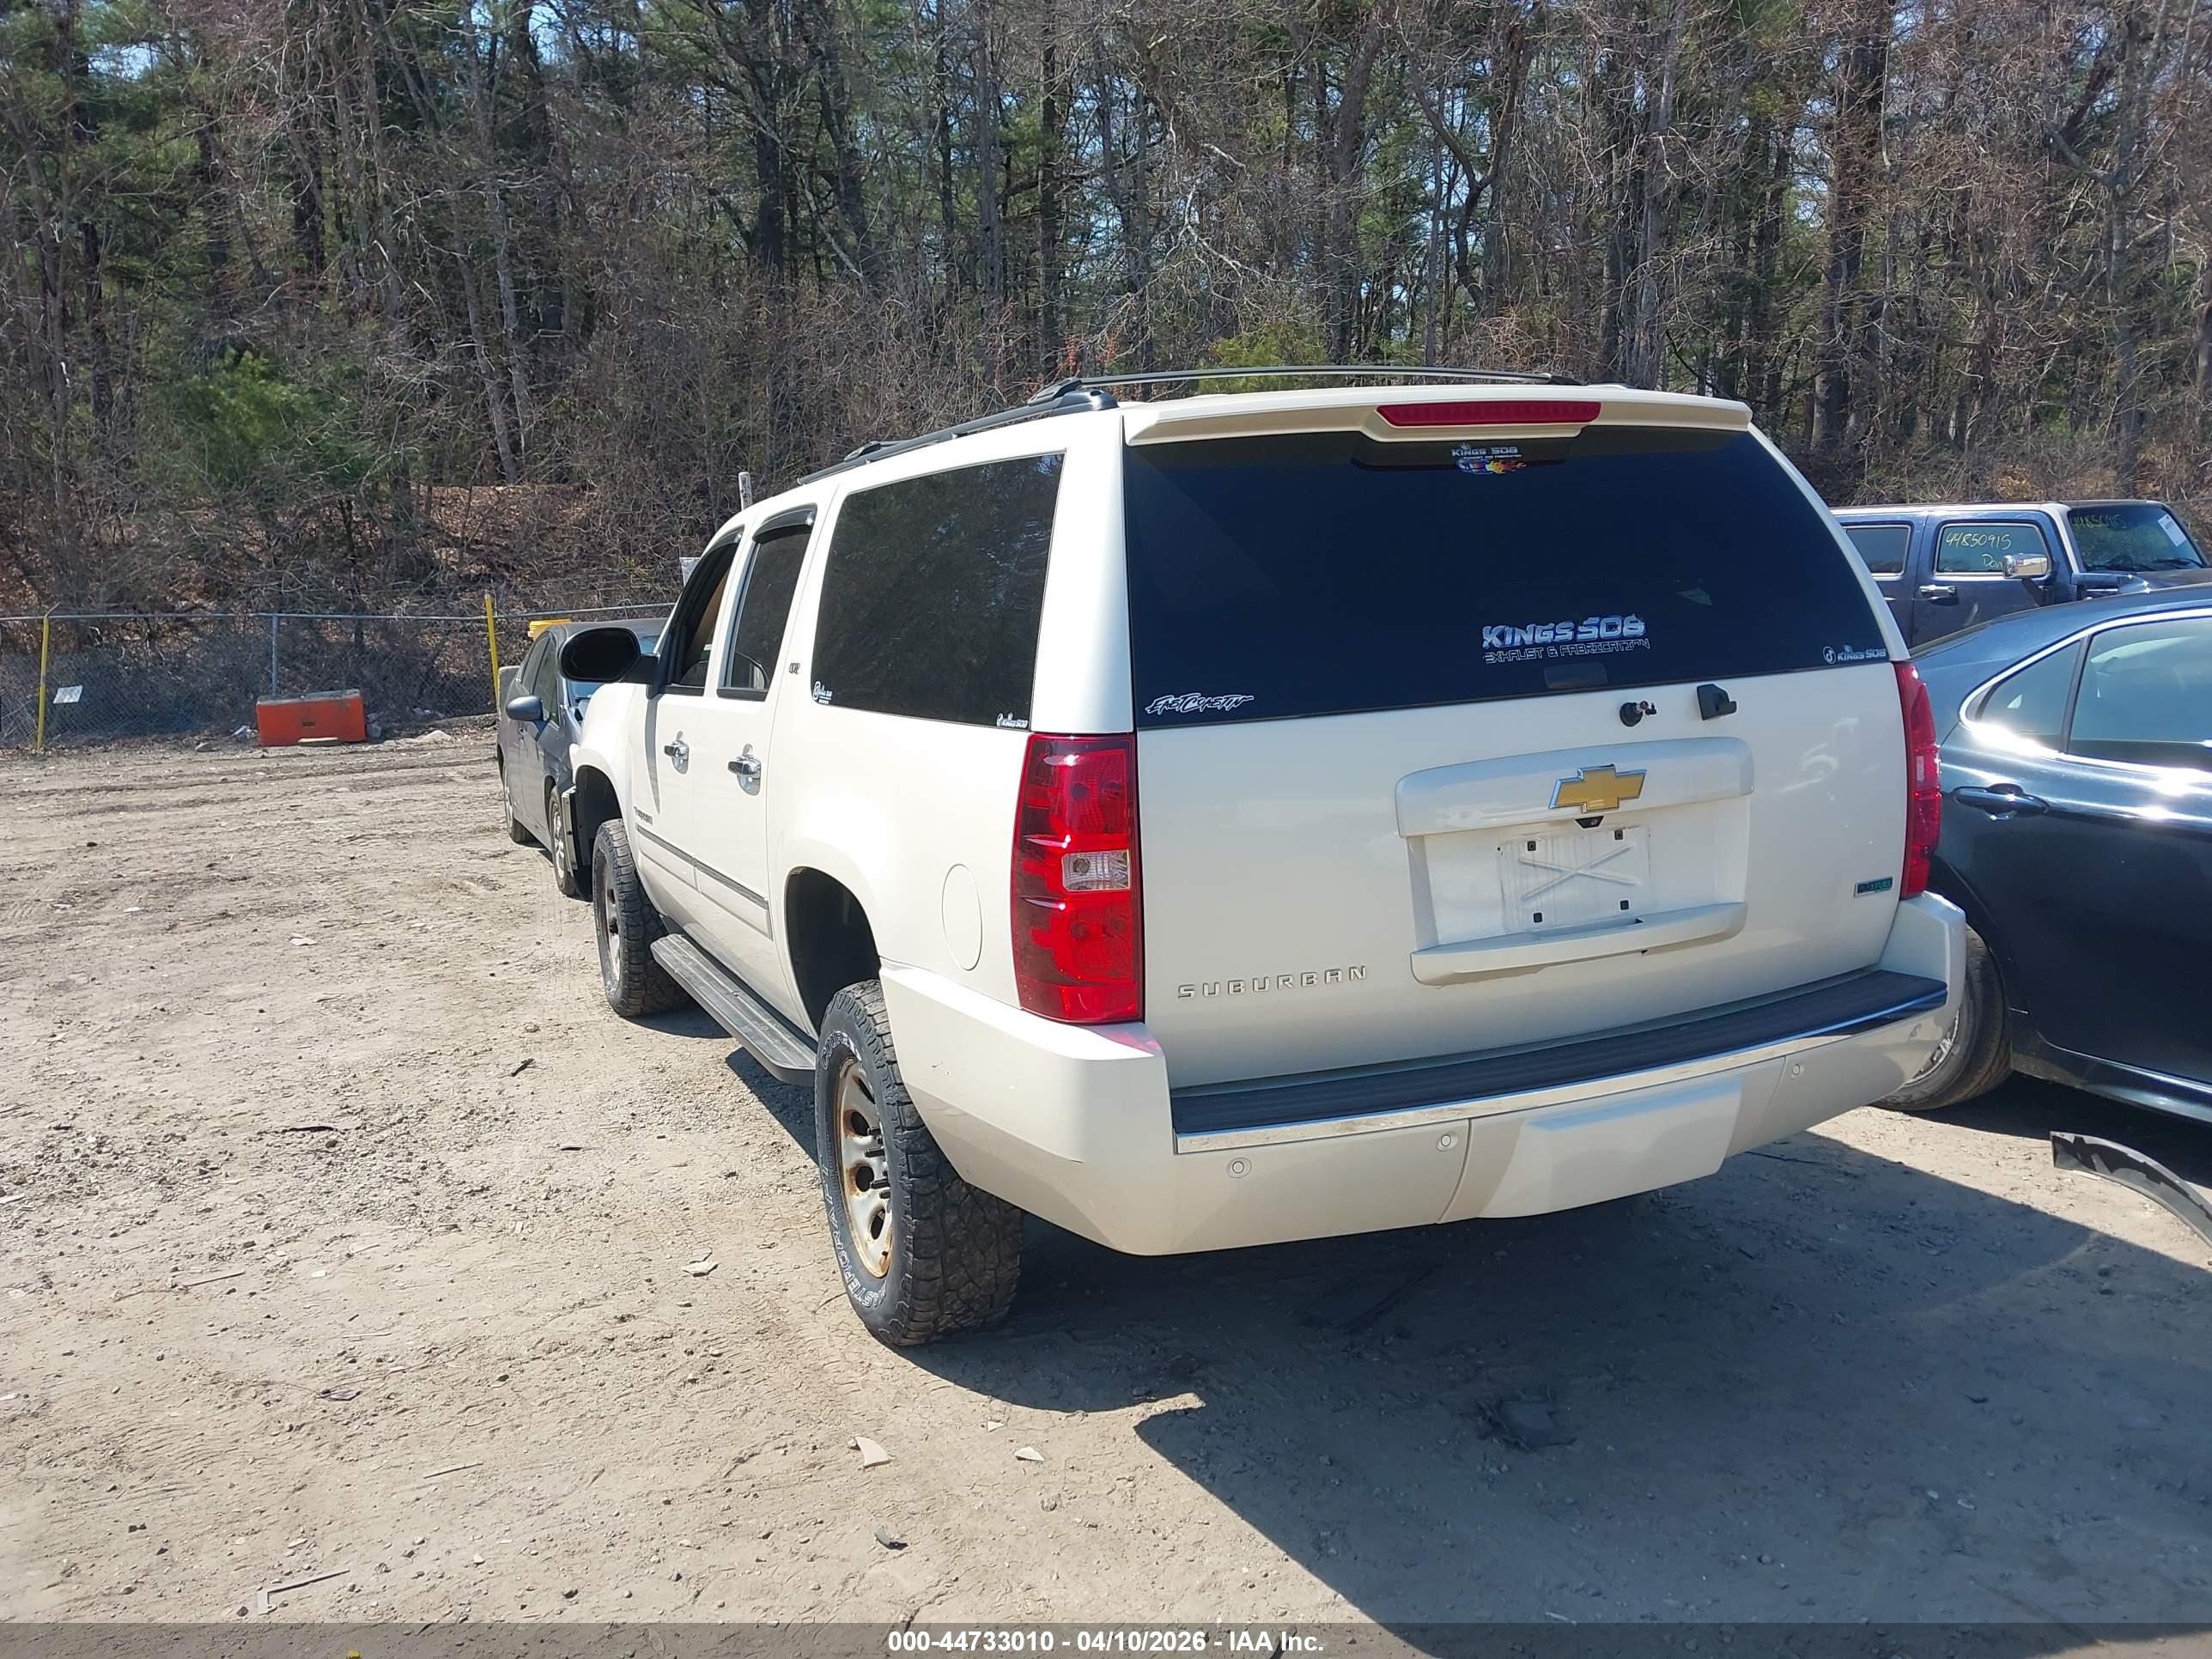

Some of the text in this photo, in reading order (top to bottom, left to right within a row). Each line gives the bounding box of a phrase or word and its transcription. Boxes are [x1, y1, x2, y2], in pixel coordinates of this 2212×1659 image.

[1946, 532, 2012, 550] 44850915
[1482, 614, 1645, 649] KINGS 508
[1483, 638, 1651, 664] EXHAUST & FABRICATION
[1177, 966, 1367, 1000] SUBURBAN
